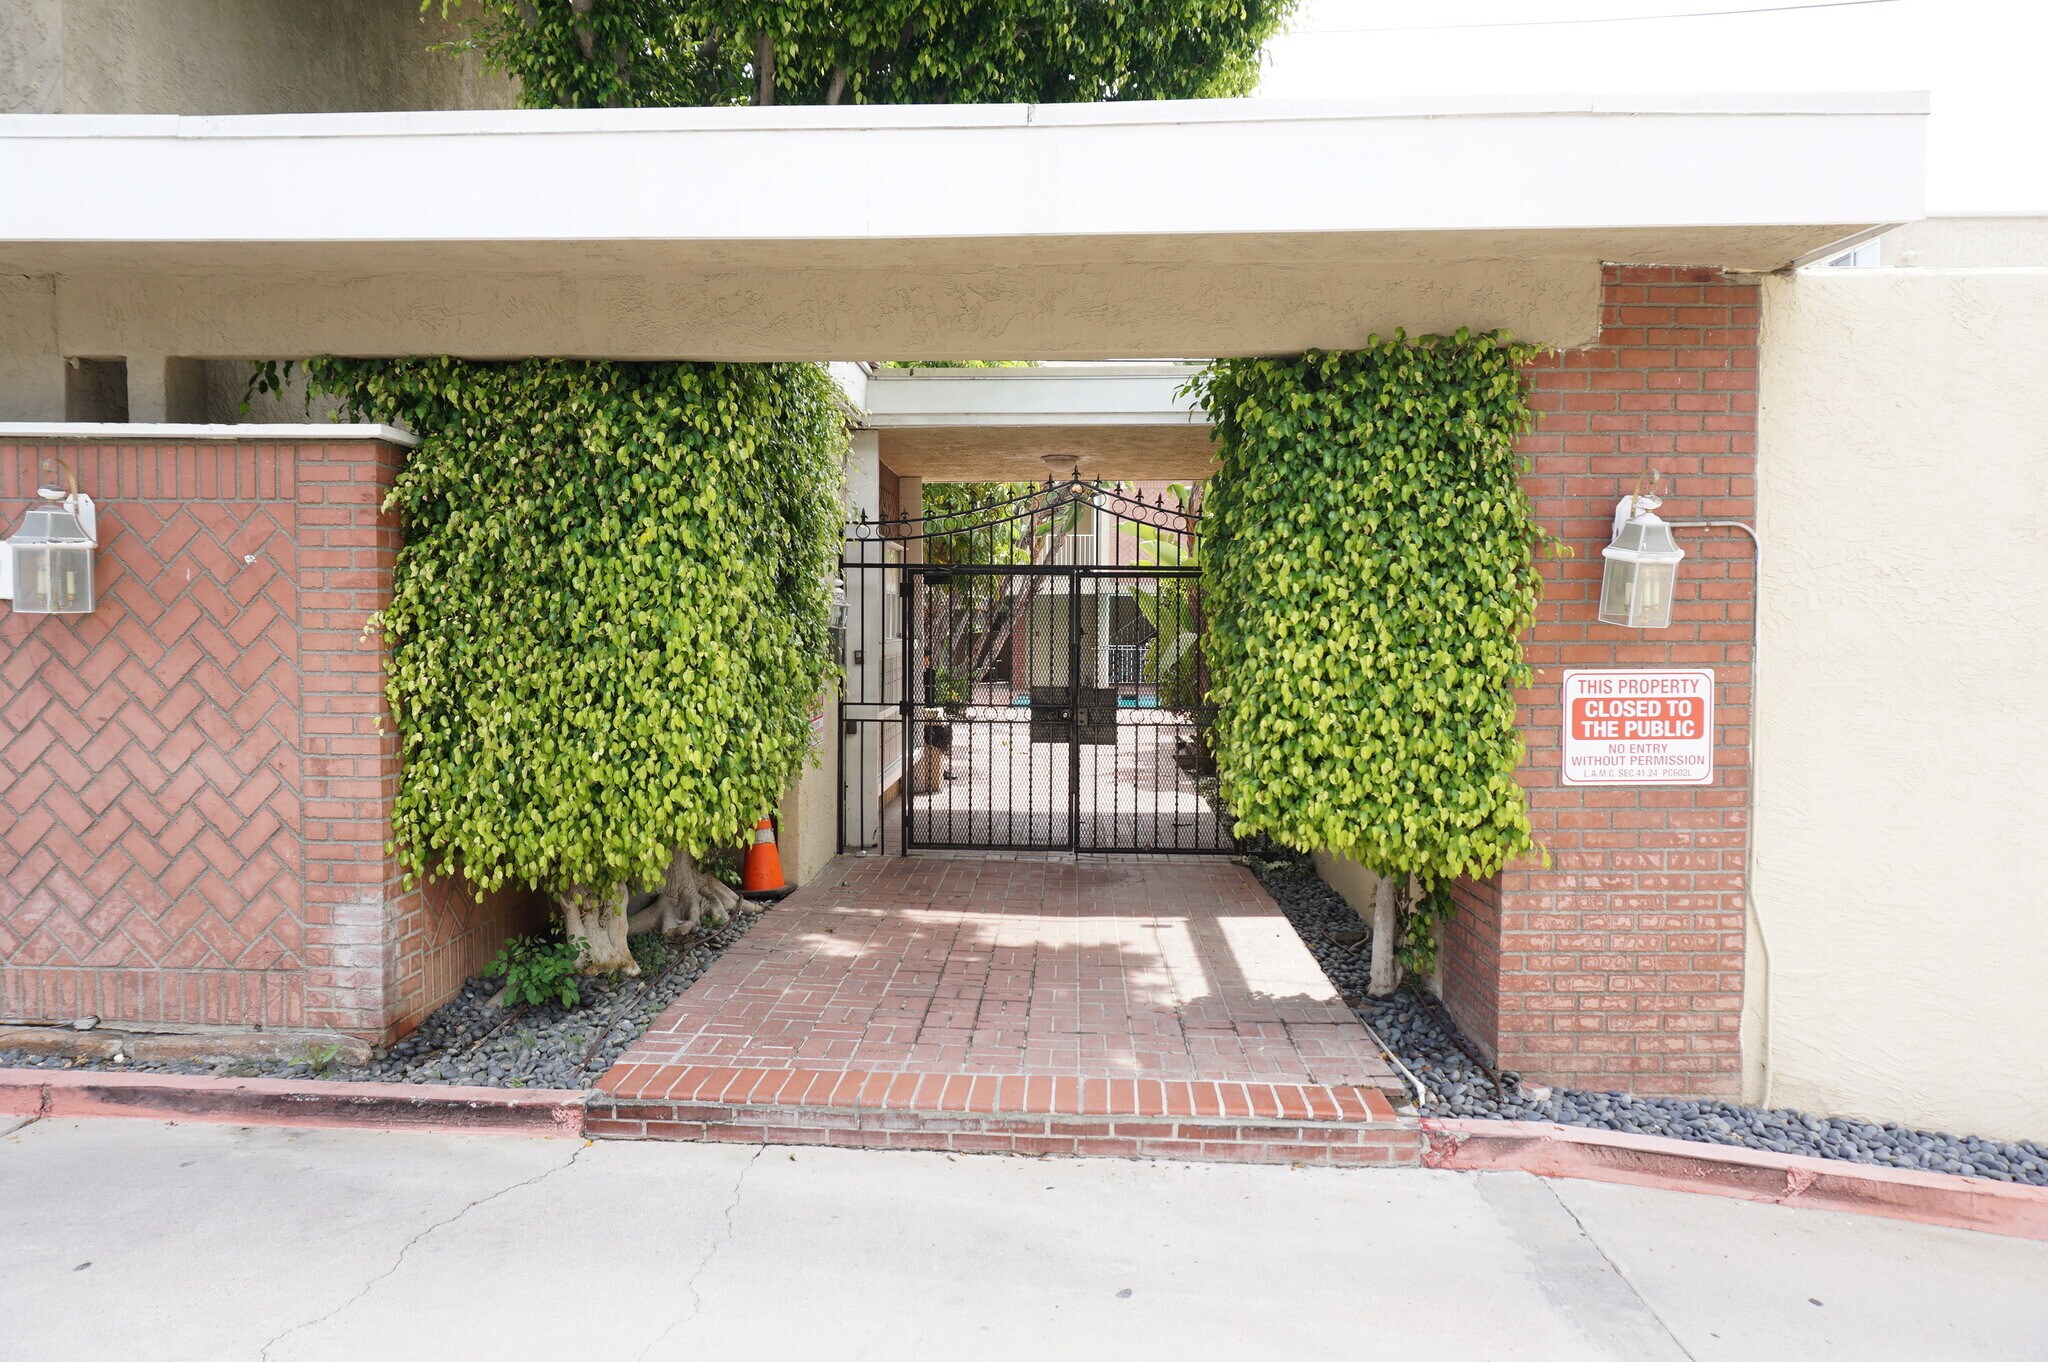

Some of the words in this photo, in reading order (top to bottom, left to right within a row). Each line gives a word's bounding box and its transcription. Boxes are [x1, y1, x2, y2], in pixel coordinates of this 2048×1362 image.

[1578, 679, 1612, 694] THIS
[1619, 679, 1699, 694] PROPERTY
[1585, 700, 1661, 717] CLOSED
[1666, 700, 1692, 717] TO
[1581, 721, 1619, 737] THE
[1625, 720, 1695, 737] PUBLIC
[1609, 744, 1625, 753] NO
[1630, 744, 1668, 753] ENTRY
[1571, 756, 1626, 766] WITHOUT
[1630, 755, 1705, 765] PERMISSION
